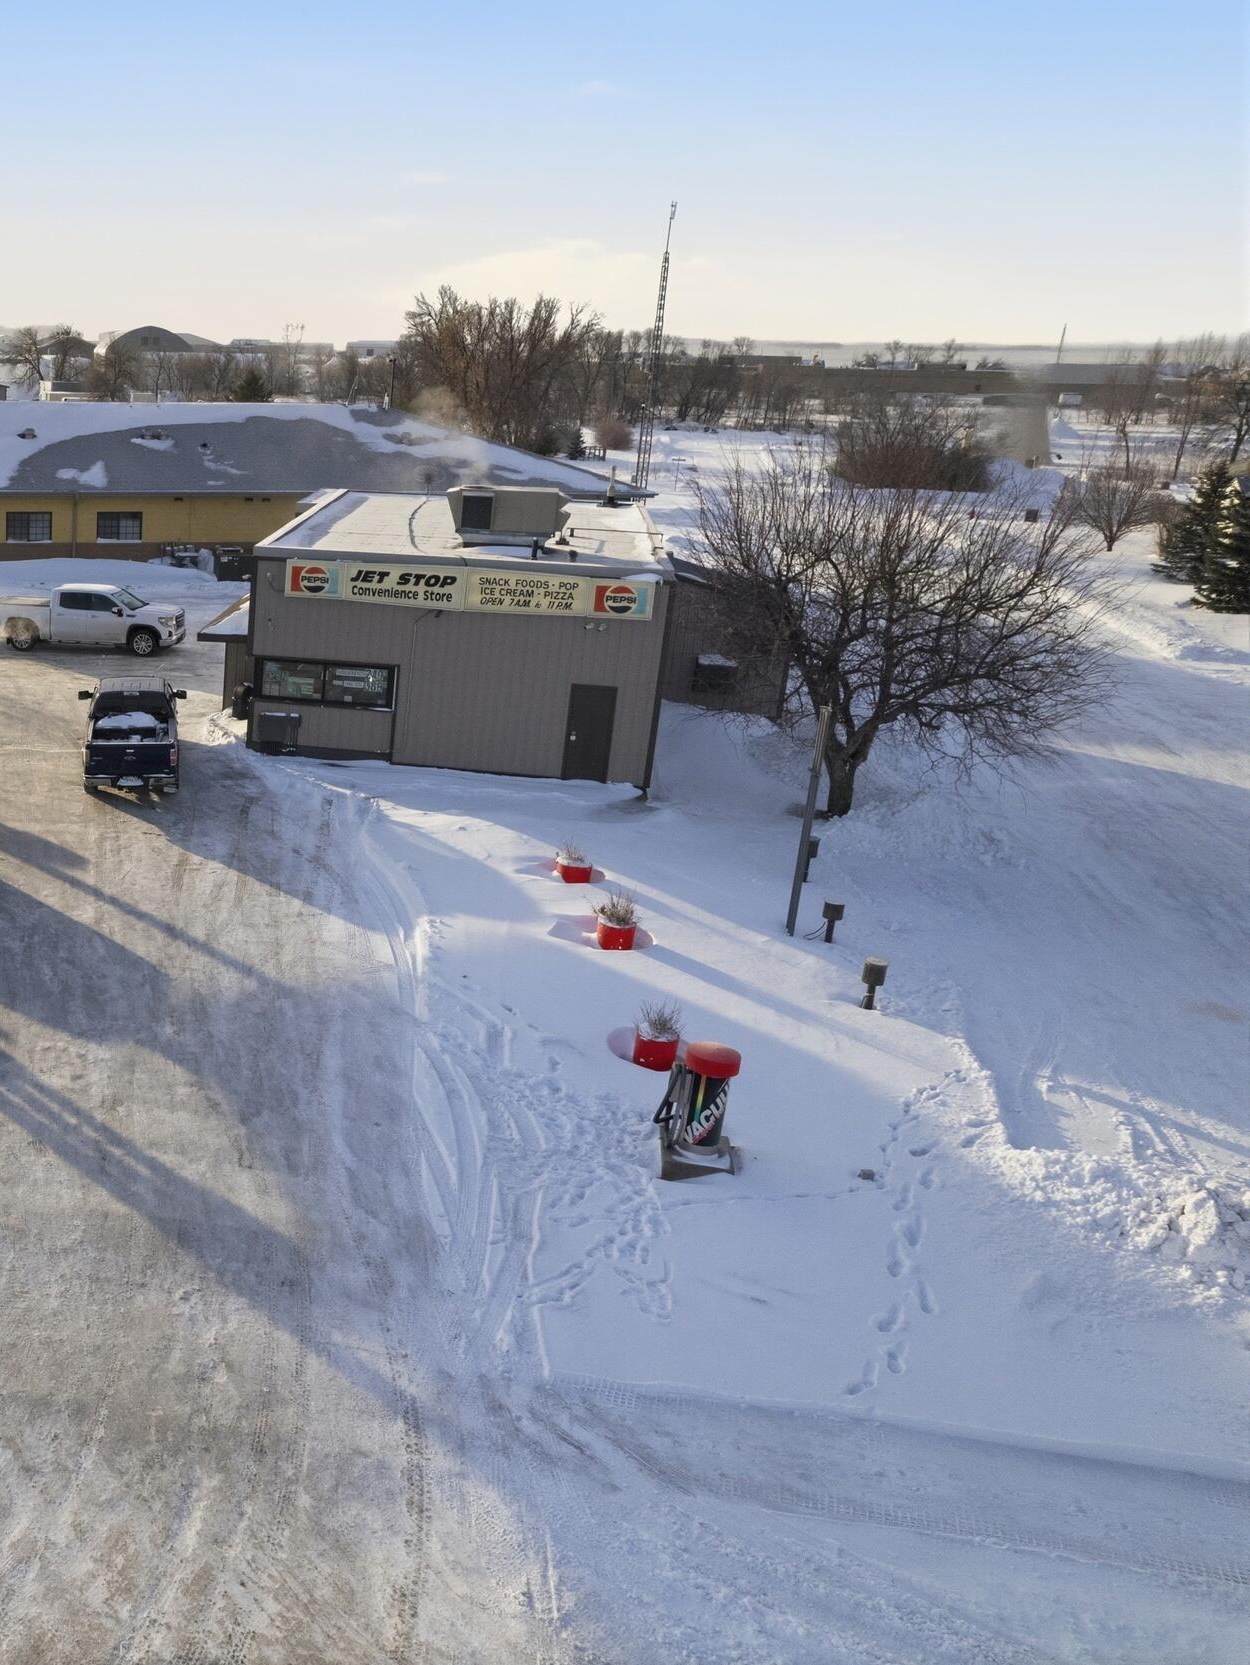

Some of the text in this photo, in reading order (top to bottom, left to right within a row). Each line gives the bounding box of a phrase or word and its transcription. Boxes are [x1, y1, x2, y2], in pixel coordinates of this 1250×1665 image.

[301, 575, 329, 584] PEPSI
[350, 569, 458, 589] JET STOP
[479, 577, 579, 591] SNACK FOODS POP
[351, 585, 453, 603] Convenience Store
[480, 587, 575, 601] ICE CREAM PIZZA
[606, 595, 637, 604] PEPSI
[479, 597, 505, 606] OPEN
